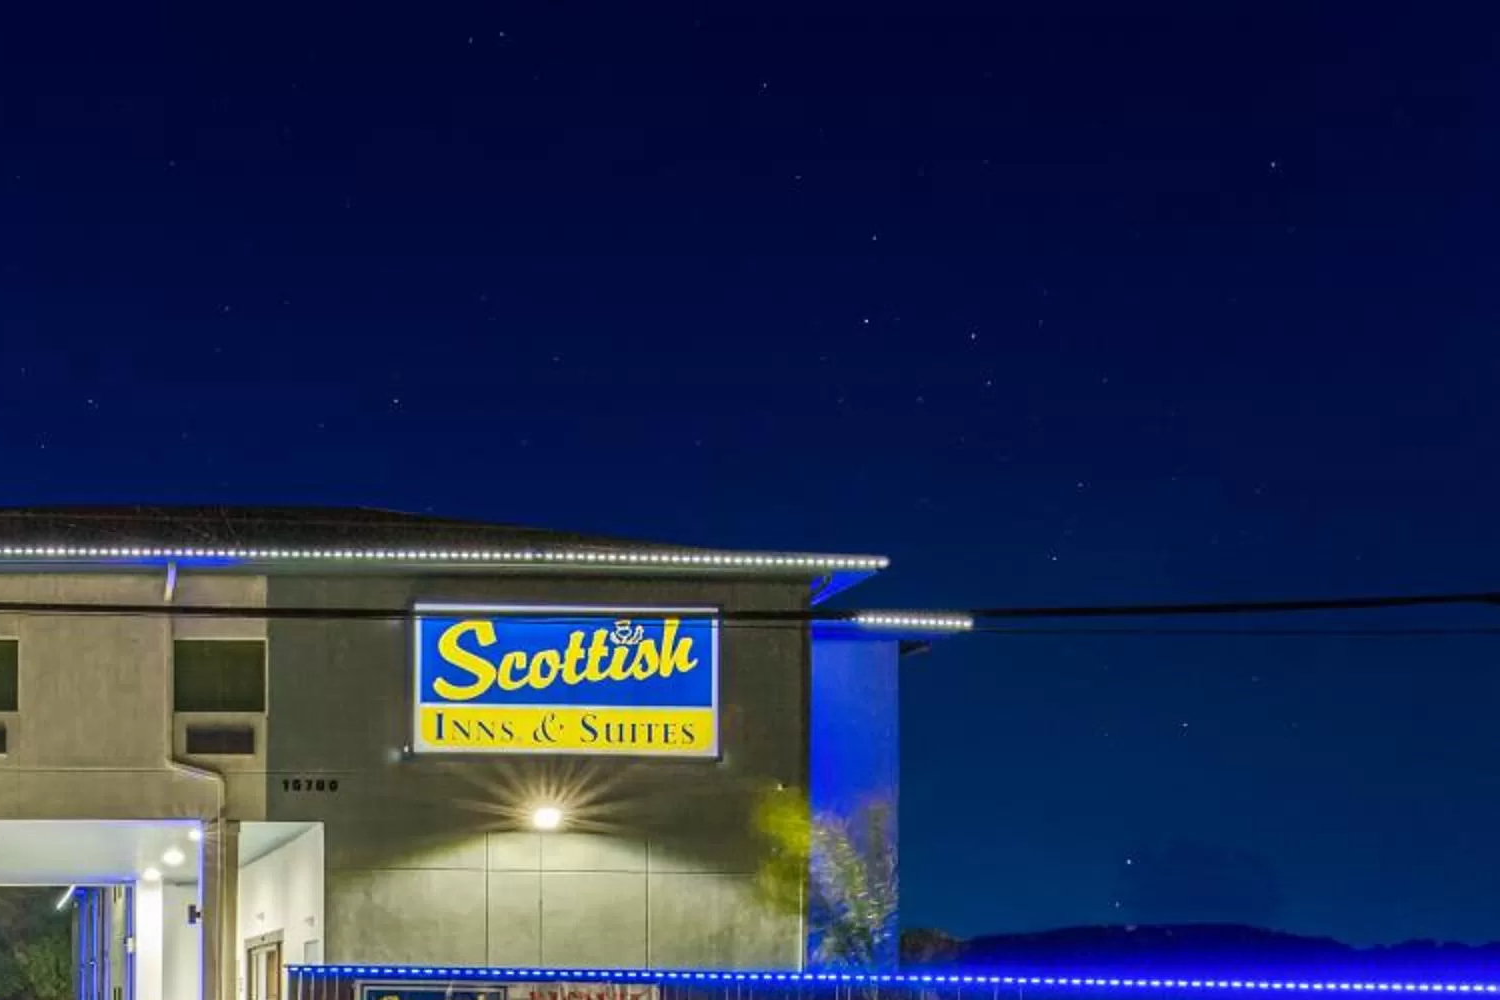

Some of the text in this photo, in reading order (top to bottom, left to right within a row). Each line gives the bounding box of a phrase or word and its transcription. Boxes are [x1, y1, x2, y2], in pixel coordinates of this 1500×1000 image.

[432, 617, 699, 701] Scottish
[435, 712, 696, 745] INNS & SUITES
